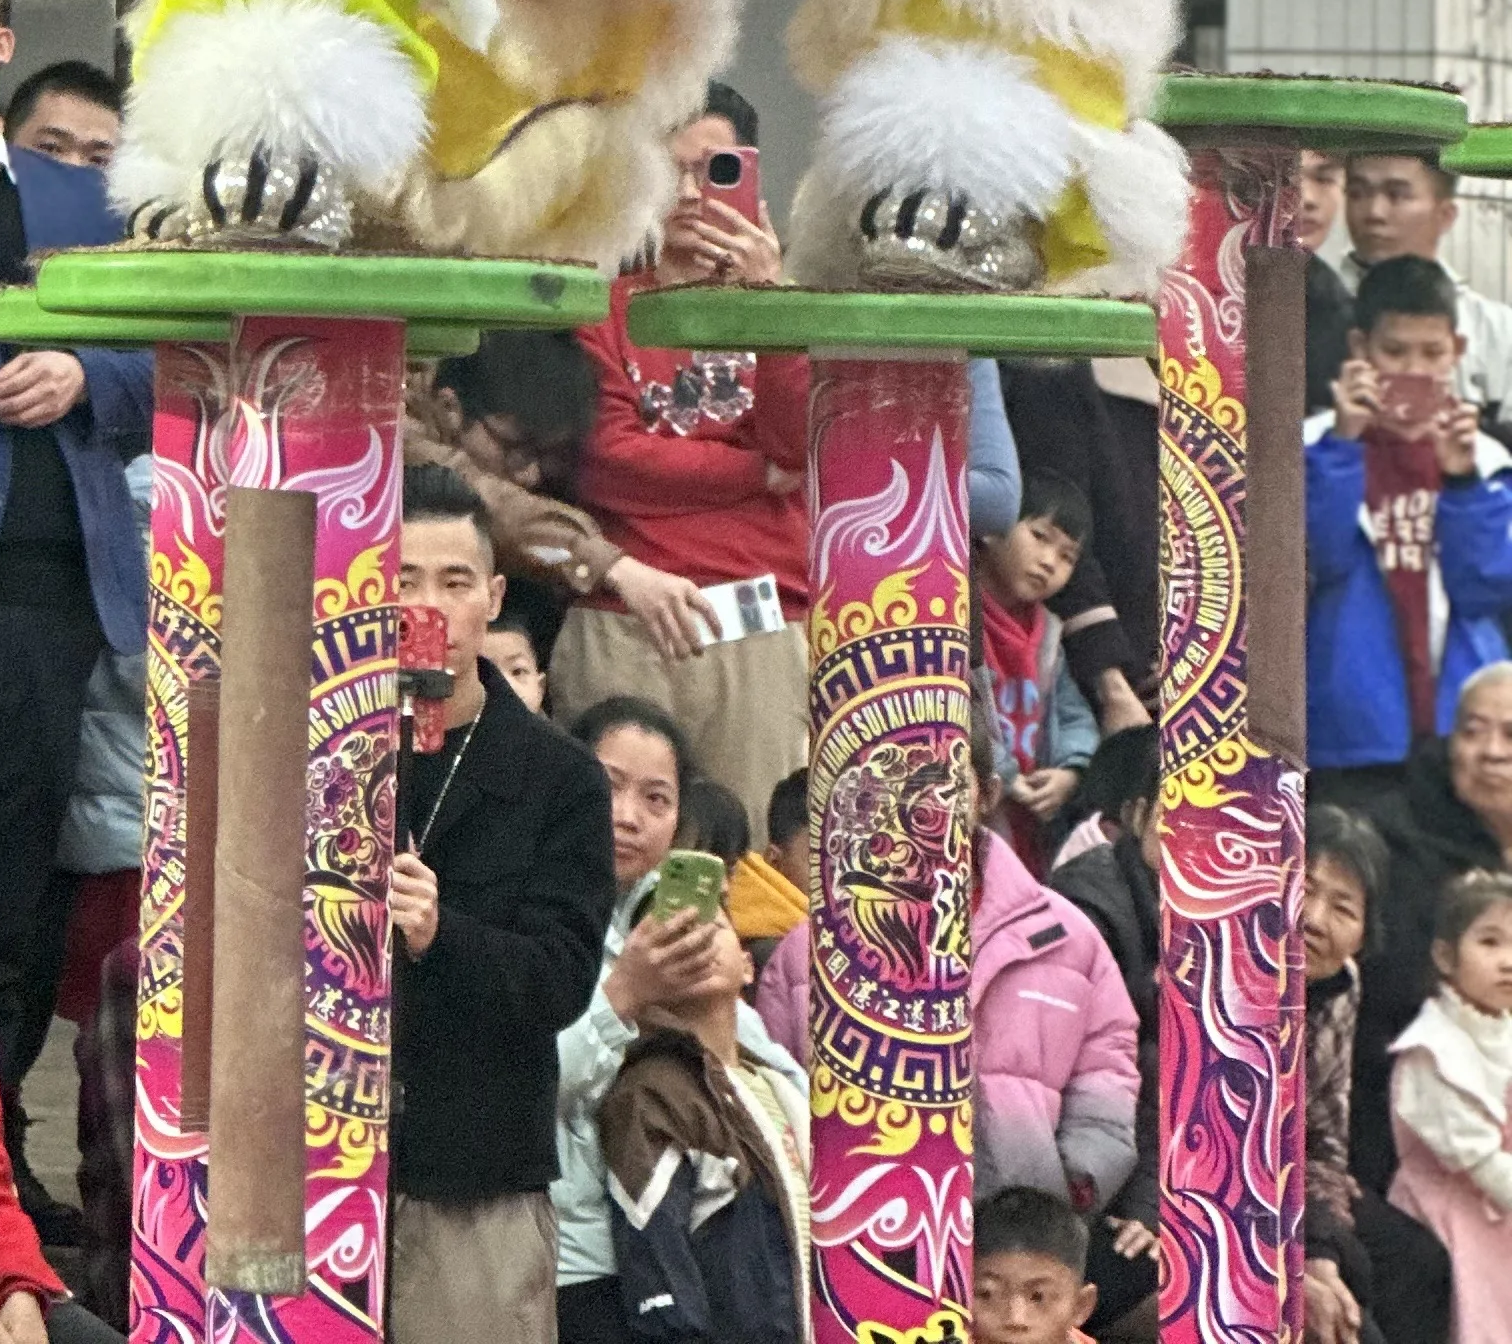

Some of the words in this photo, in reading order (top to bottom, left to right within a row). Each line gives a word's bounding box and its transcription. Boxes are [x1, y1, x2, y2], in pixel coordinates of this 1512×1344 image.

[1181, 487, 1216, 529] LION
[1194, 523, 1230, 633] ASSOCIATION
[321, 686, 360, 730] SUI
[354, 677, 374, 716] XI
[850, 700, 889, 743] SUI
[882, 693, 907, 730] XI
[902, 688, 945, 725] LONG
